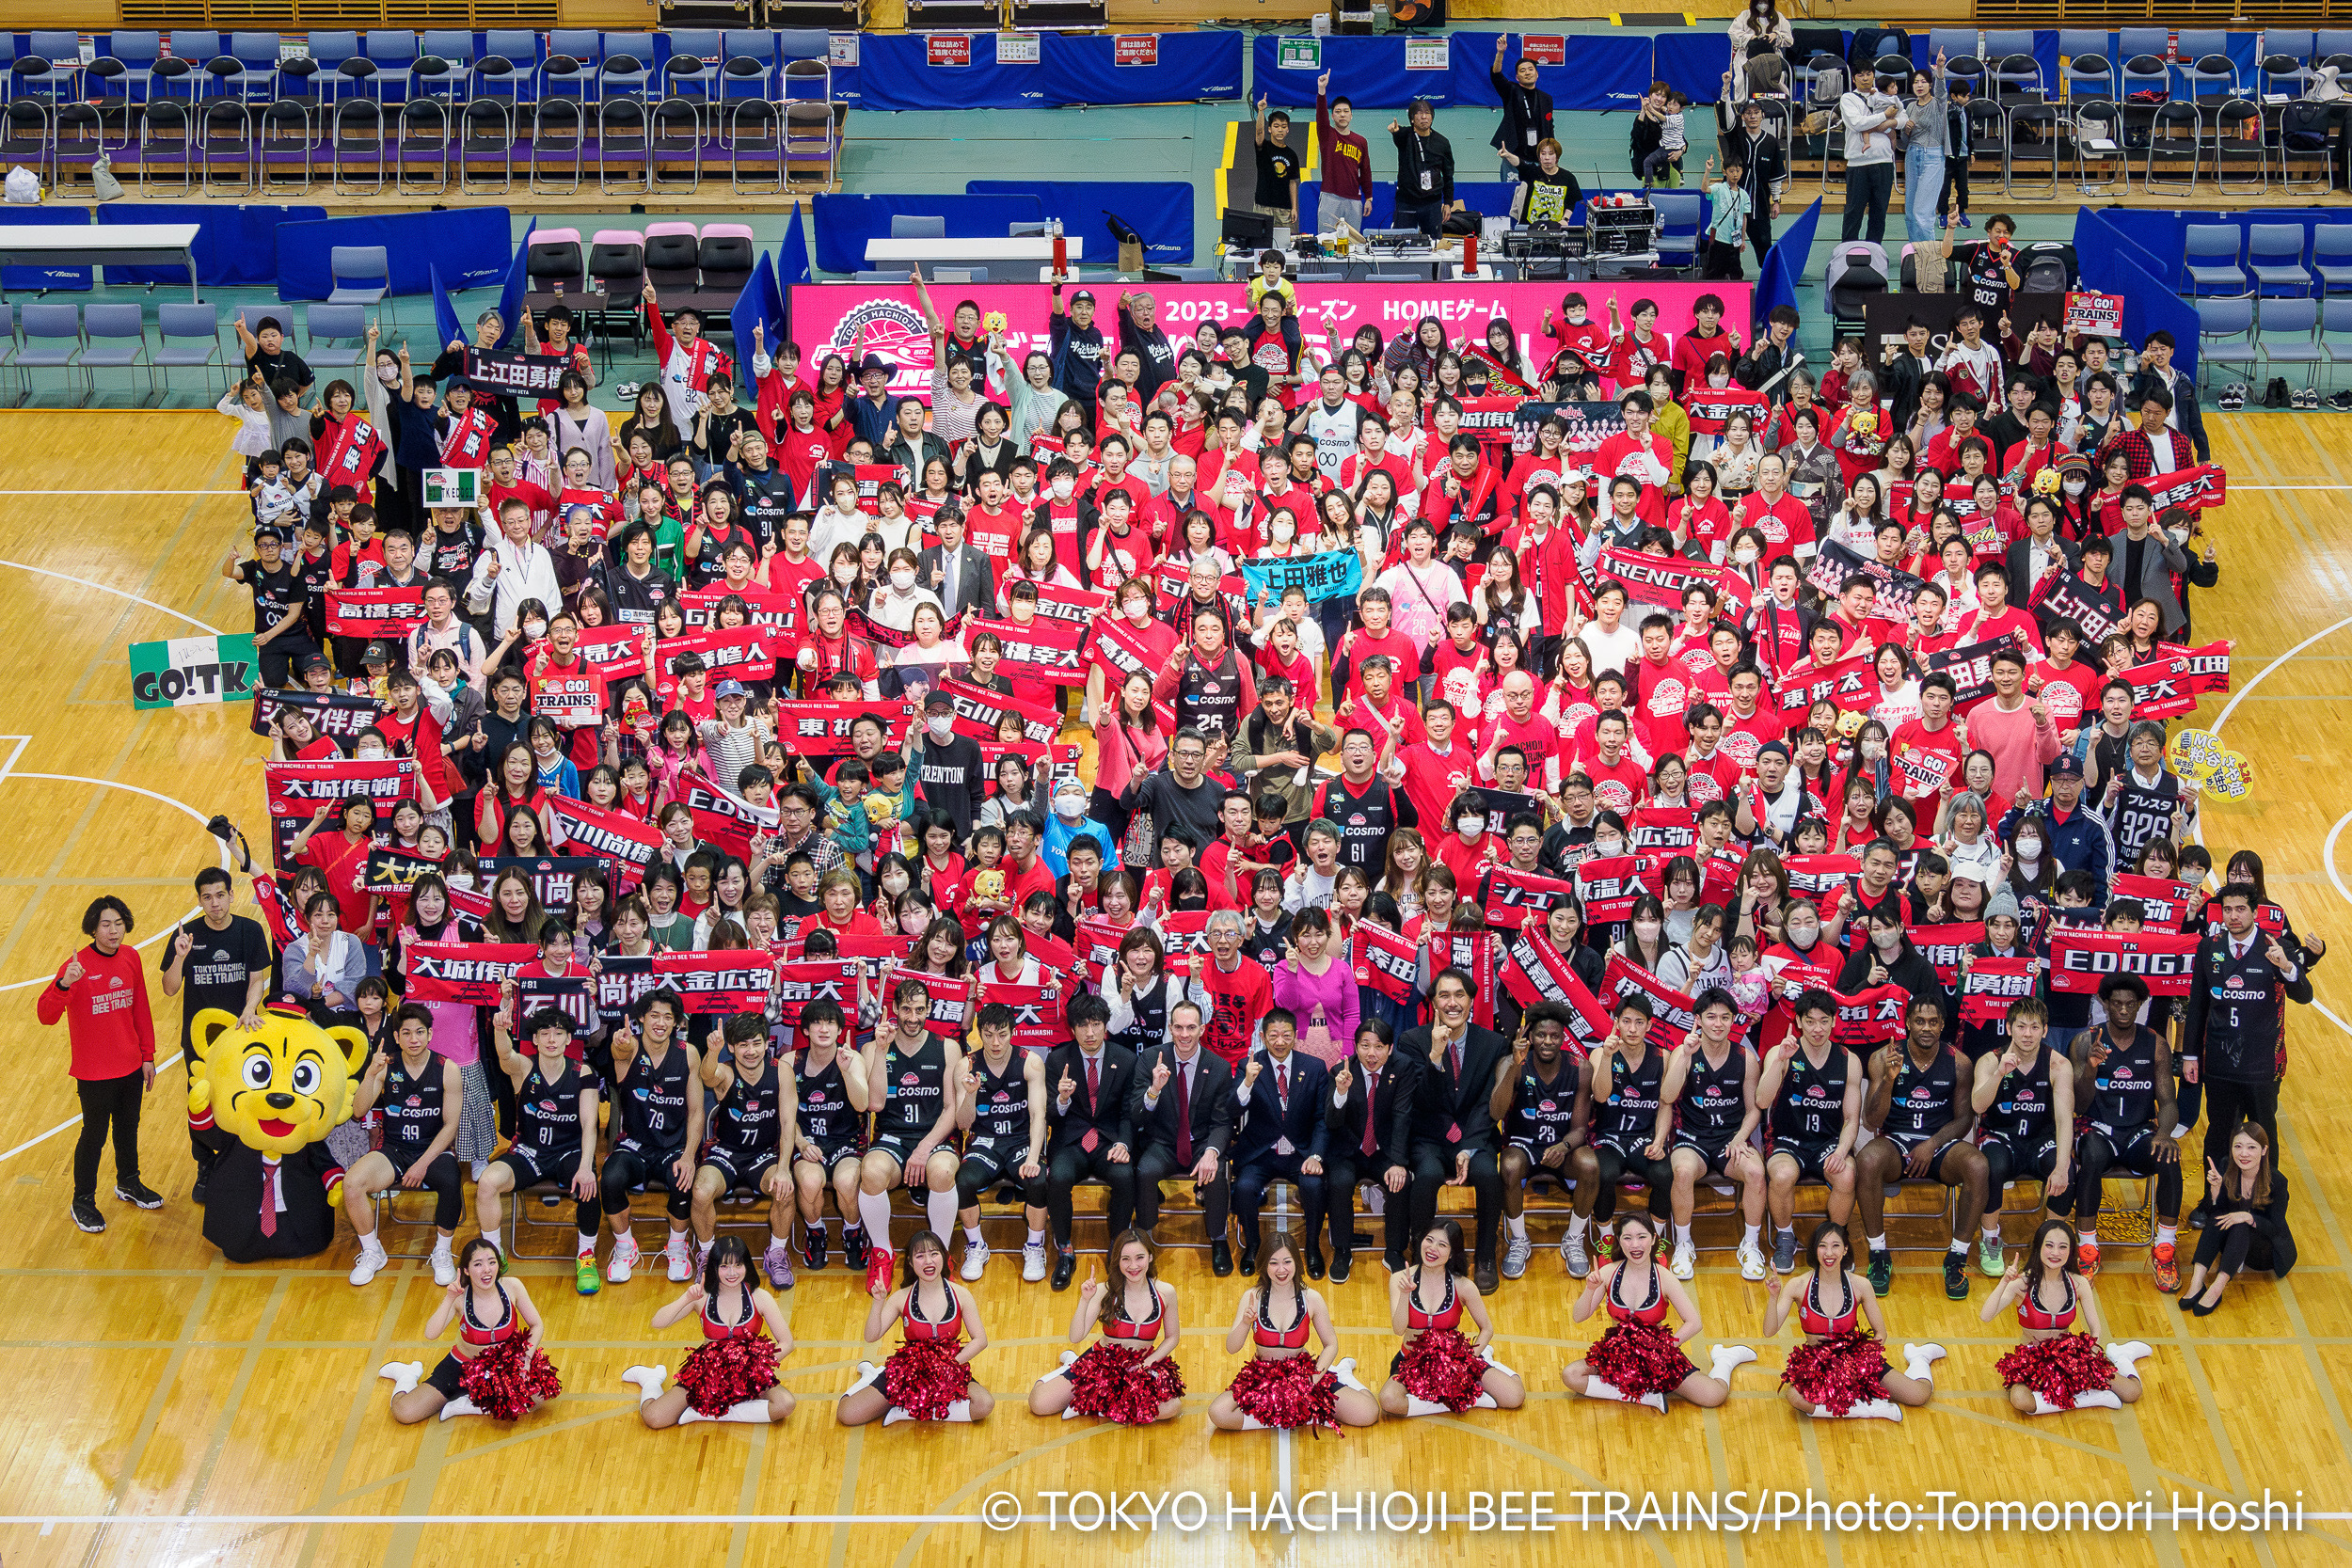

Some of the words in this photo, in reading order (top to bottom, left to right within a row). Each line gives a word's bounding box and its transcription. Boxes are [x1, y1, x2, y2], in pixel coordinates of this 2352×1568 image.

[1980, 278, 2007, 288] cosmo
[1974, 289, 1997, 305] 803
[2094, 298, 2113, 309] GO!
[1384, 299, 1507, 321] HOMEゲーム
[2068, 308, 2119, 322] TRAINS!
[871, 310, 916, 331] HACHIOJI
[685, 388, 697, 404] 32
[1319, 438, 1350, 448] cosmo
[2000, 485, 2011, 495] 30
[603, 495, 612, 503] 30
[761, 520, 771, 536] 31
[2060, 573, 2071, 582] #8
[631, 626, 644, 635] 56
[766, 627, 776, 637] 14
[1412, 618, 1427, 636] 26
[2170, 662, 2183, 673] 30
[565, 680, 589, 692] GO!
[535, 693, 597, 707] TRAINS!
[1206, 694, 1236, 705] cosmo
[903, 705, 913, 714] 13
[952, 693, 1054, 744] 石川樹
[1197, 714, 1223, 733] 26
[2194, 734, 2217, 750] MC
[2171, 748, 2188, 758] 3.26
[2188, 748, 2220, 768] 粕谷
[398, 762, 413, 772] 99
[1924, 754, 1947, 772] GO!
[2062, 758, 2070, 768] B
[2174, 758, 2194, 769] 誕生日
[1346, 827, 1385, 835] cosmo
[2121, 811, 2169, 847] 326
[1352, 844, 1364, 862] 61
[480, 860, 494, 868] #81
[1636, 859, 1645, 870] 17
[2270, 911, 2280, 921] 14
[2064, 950, 2195, 974] EDOGI
[194, 965, 216, 974] TOKYO
[842, 965, 857, 976] 56
[195, 974, 212, 984] BEE
[214, 971, 245, 983] TRAINS
[655, 969, 774, 990] 大金広弥
[92, 992, 111, 1005] TOKYO
[1041, 990, 1055, 999] 30
[2223, 990, 2265, 999] cosmo
[92, 1003, 109, 1015] BEE
[111, 997, 133, 1012] TRAINS
[2231, 1007, 2238, 1026] 5
[2109, 1081, 2152, 1089] cosmo
[898, 1087, 939, 1096] cosmo
[649, 1094, 684, 1105] cosmo
[1621, 1100, 1659, 1108] cosmo
[1704, 1096, 1738, 1106] cosmo
[1803, 1097, 1841, 1109] cosmo
[402, 1107, 440, 1117] cosmo
[991, 1100, 1027, 1113] cosmo
[2120, 1098, 2122, 1116] 1
[537, 1110, 577, 1121] cosmo
[649, 1109, 664, 1130] 79
[742, 1109, 775, 1122] cosmo
[905, 1104, 918, 1123] 31
[811, 1118, 826, 1135] 56
[1620, 1115, 1636, 1131] 17
[1806, 1115, 1820, 1132] 13
[540, 1127, 552, 1145] 81
[741, 1129, 758, 1145] 77
